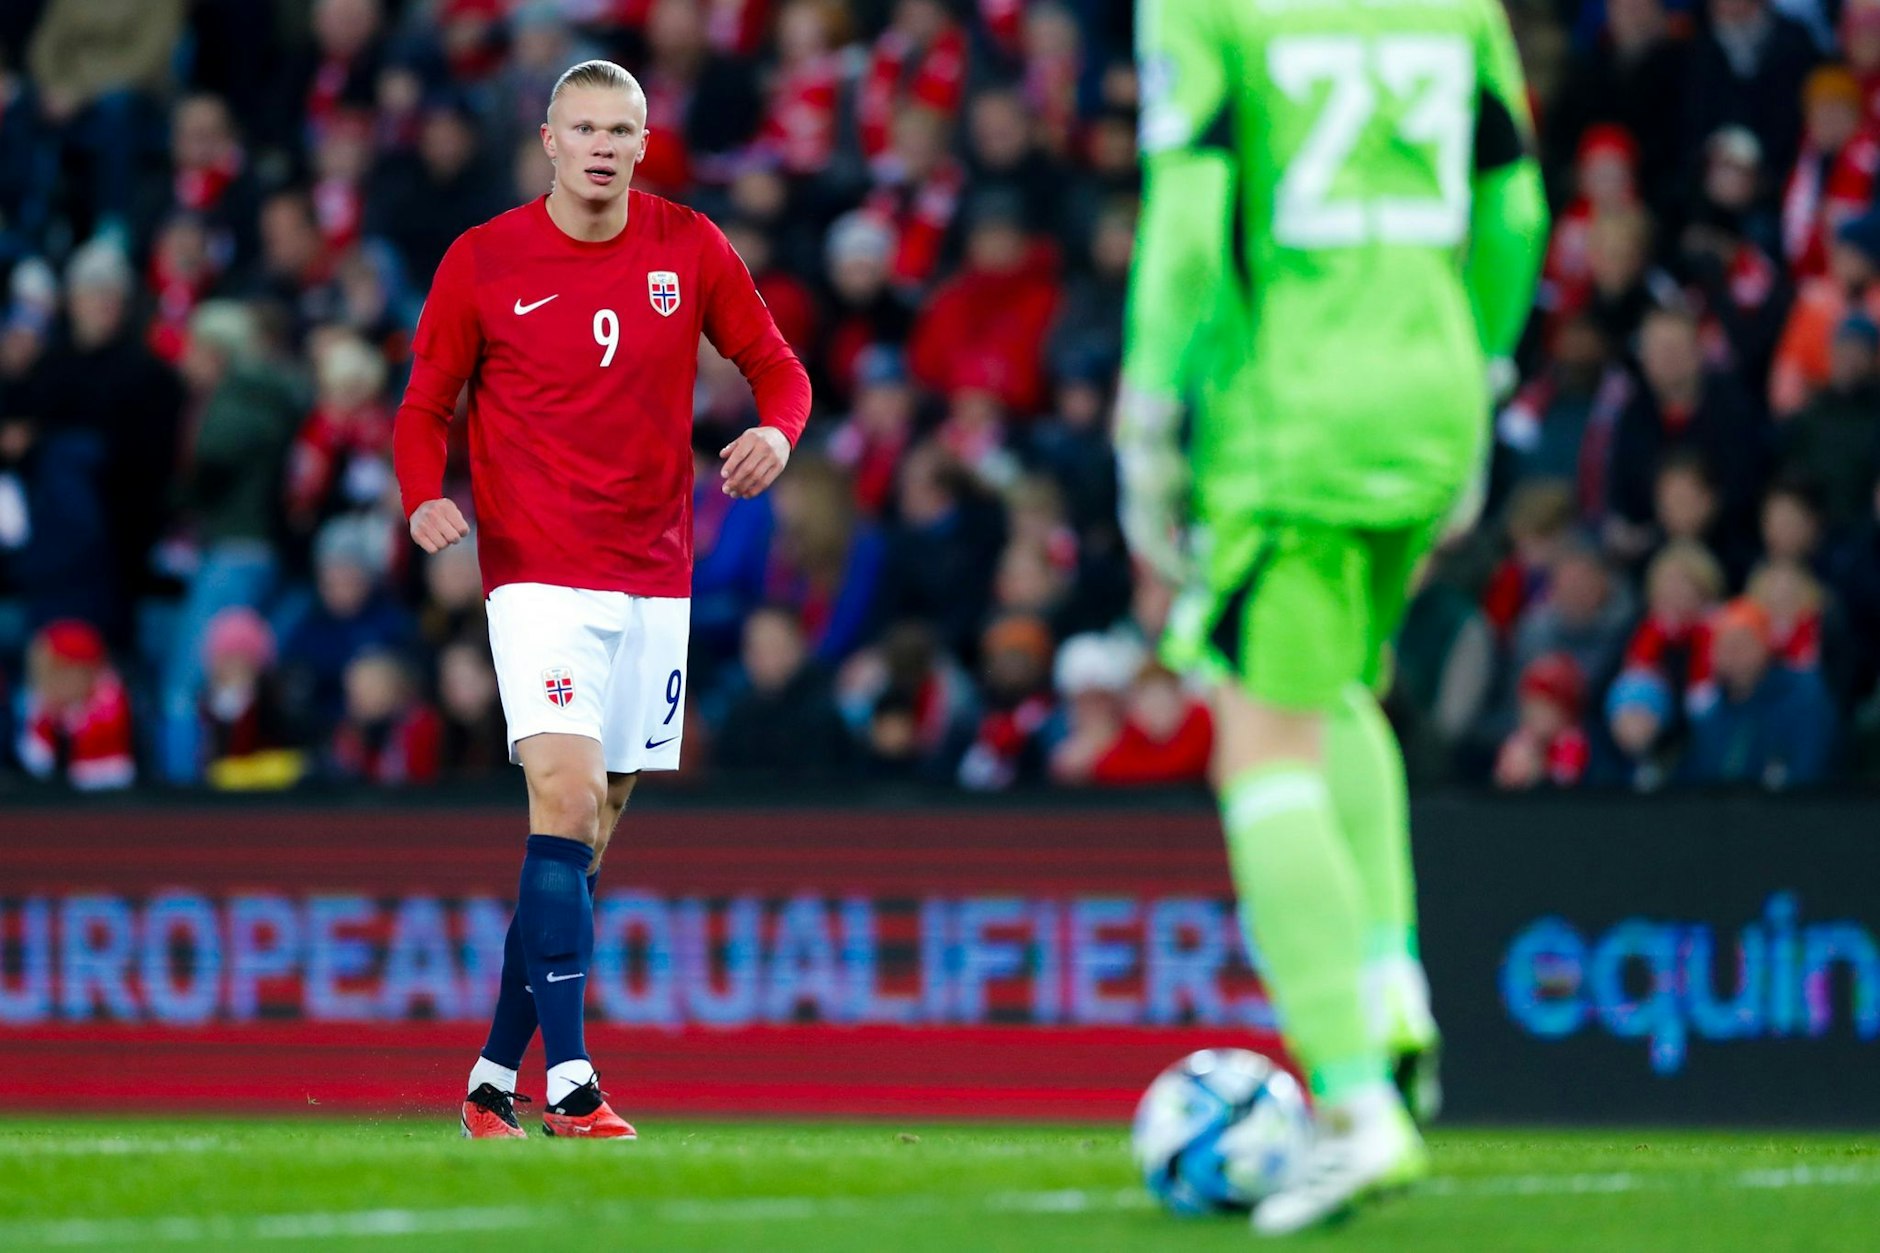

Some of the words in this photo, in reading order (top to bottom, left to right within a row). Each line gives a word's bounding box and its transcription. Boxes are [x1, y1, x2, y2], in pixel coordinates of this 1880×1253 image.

[1267, 34, 1476, 248] 23
[593, 309, 620, 367] 9
[663, 669, 681, 725] 9
[1500, 889, 1880, 1073] equin
